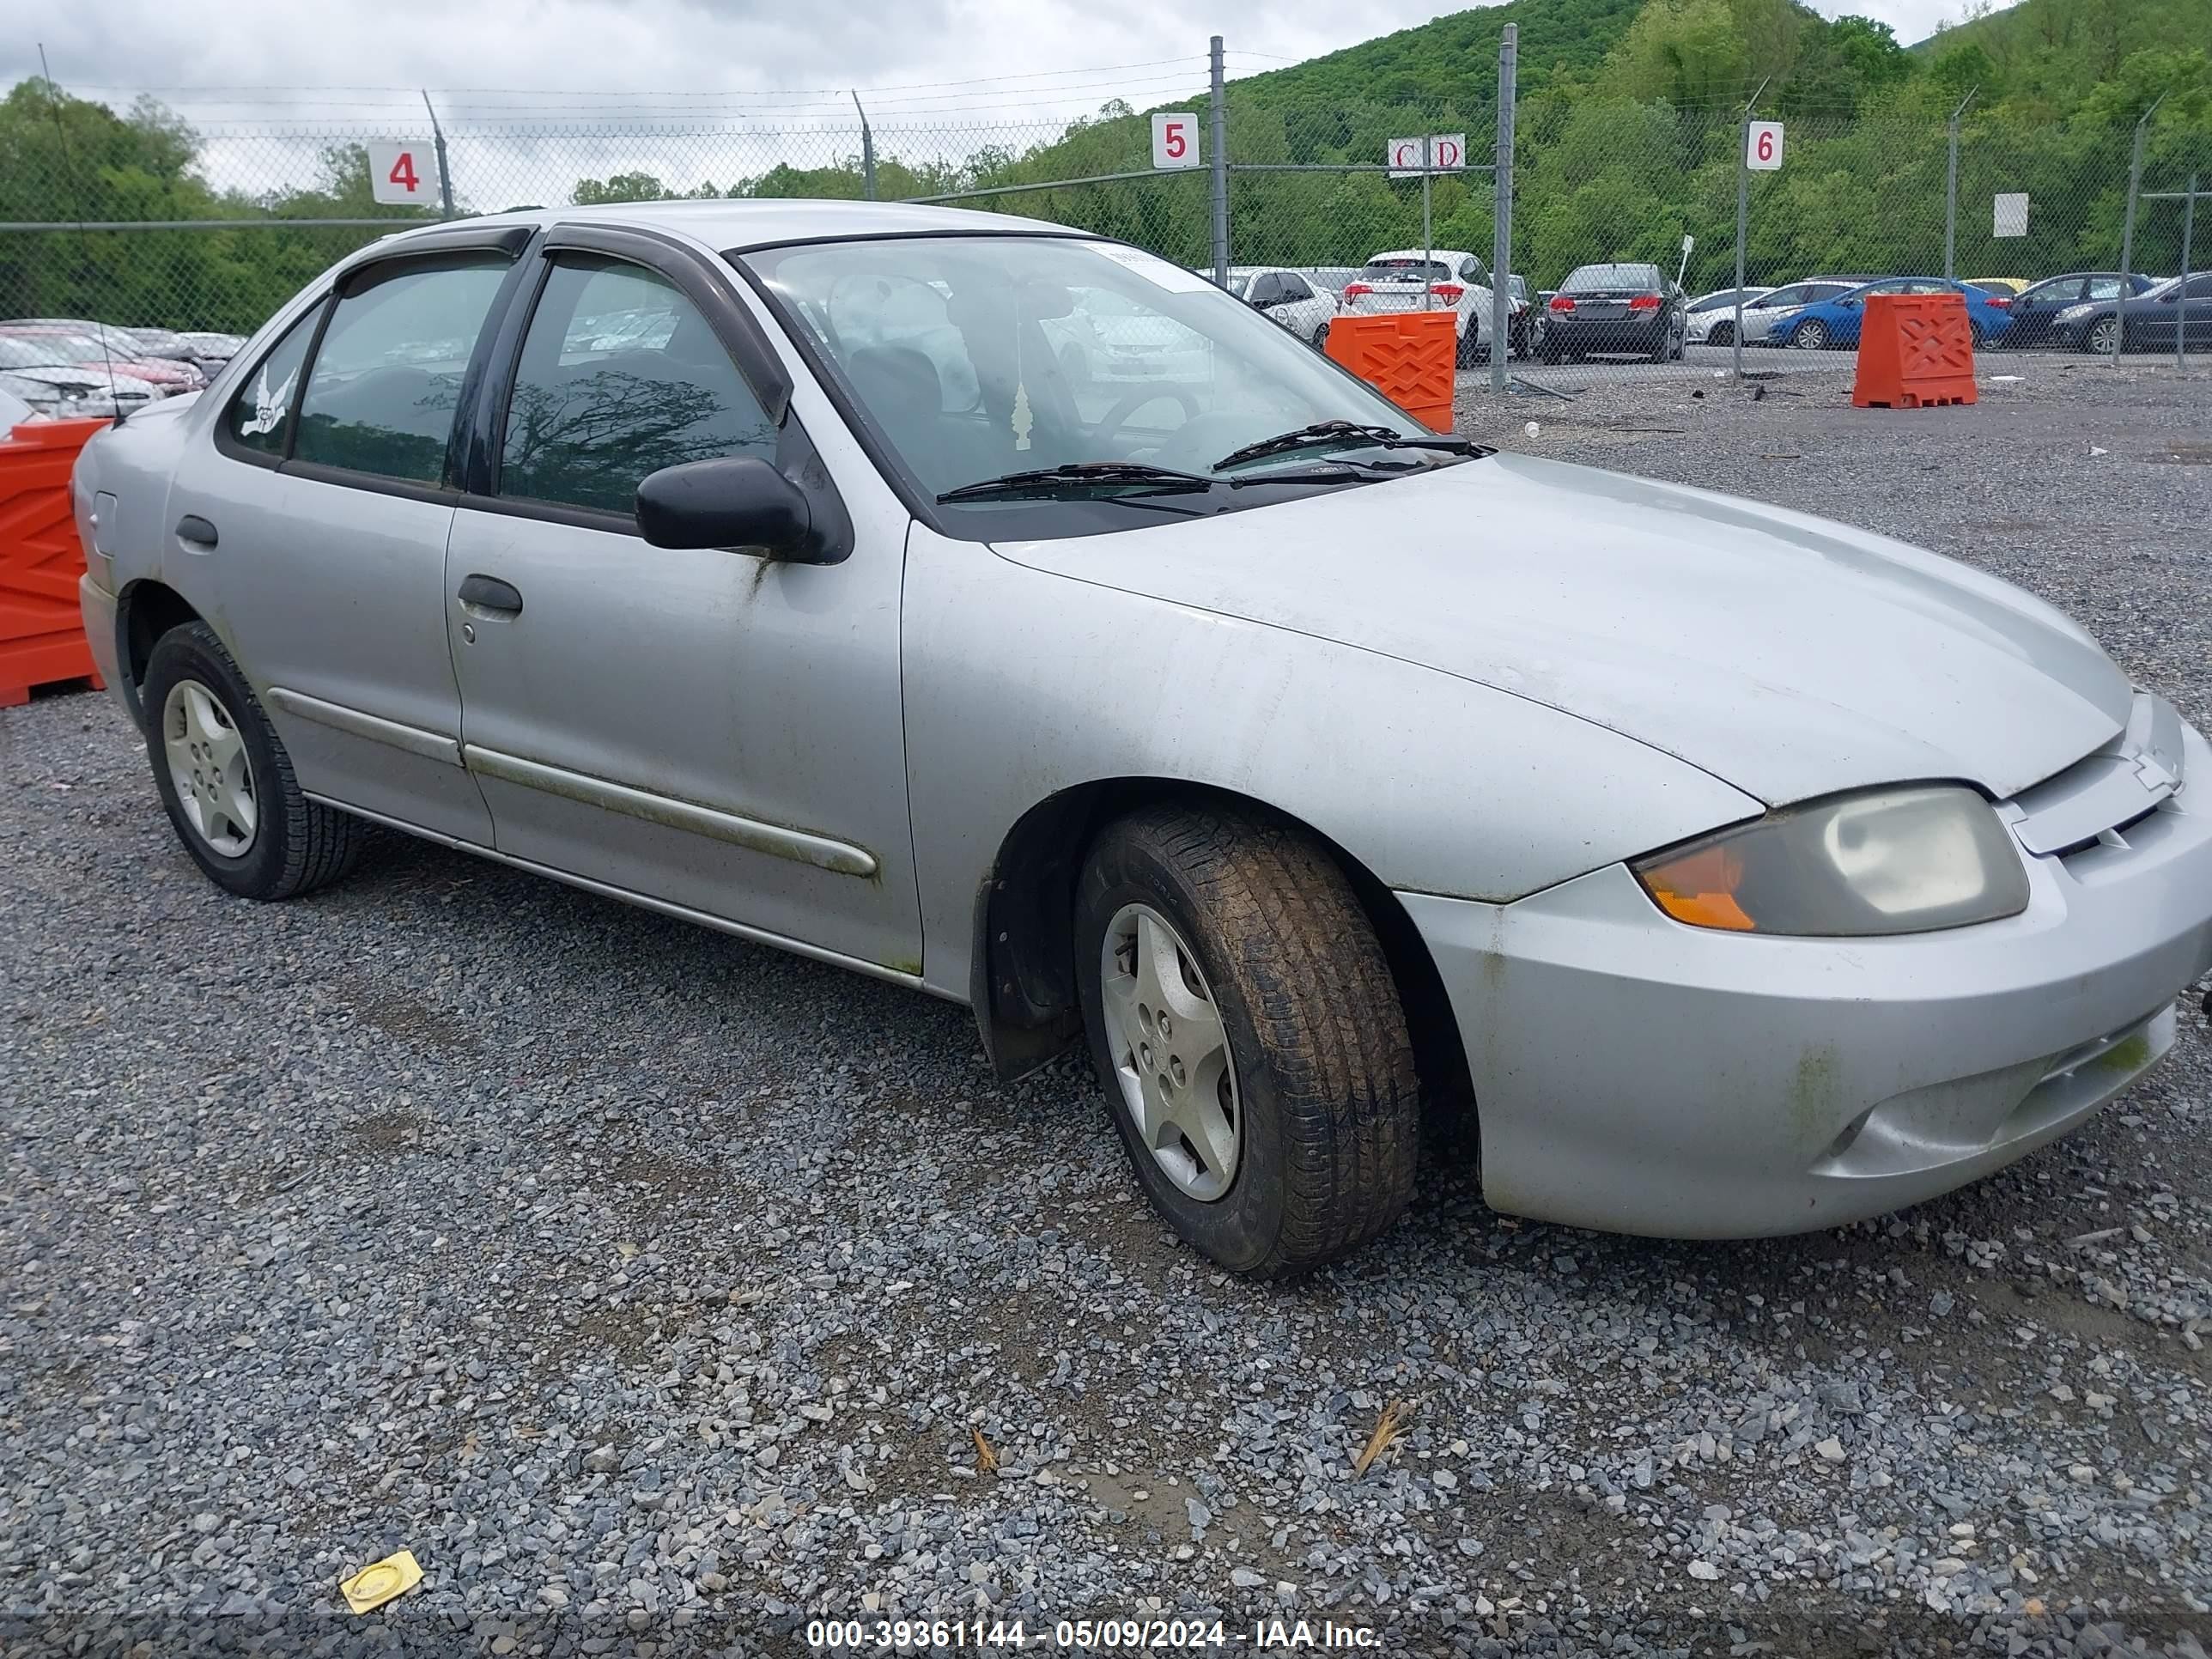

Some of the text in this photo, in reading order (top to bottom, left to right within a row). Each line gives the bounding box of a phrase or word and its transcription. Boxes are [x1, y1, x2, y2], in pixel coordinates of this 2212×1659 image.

[1166, 124, 1186, 158] 5
[1396, 141, 1458, 168] C D
[1758, 131, 1773, 161] 6
[389, 153, 419, 192] 4
